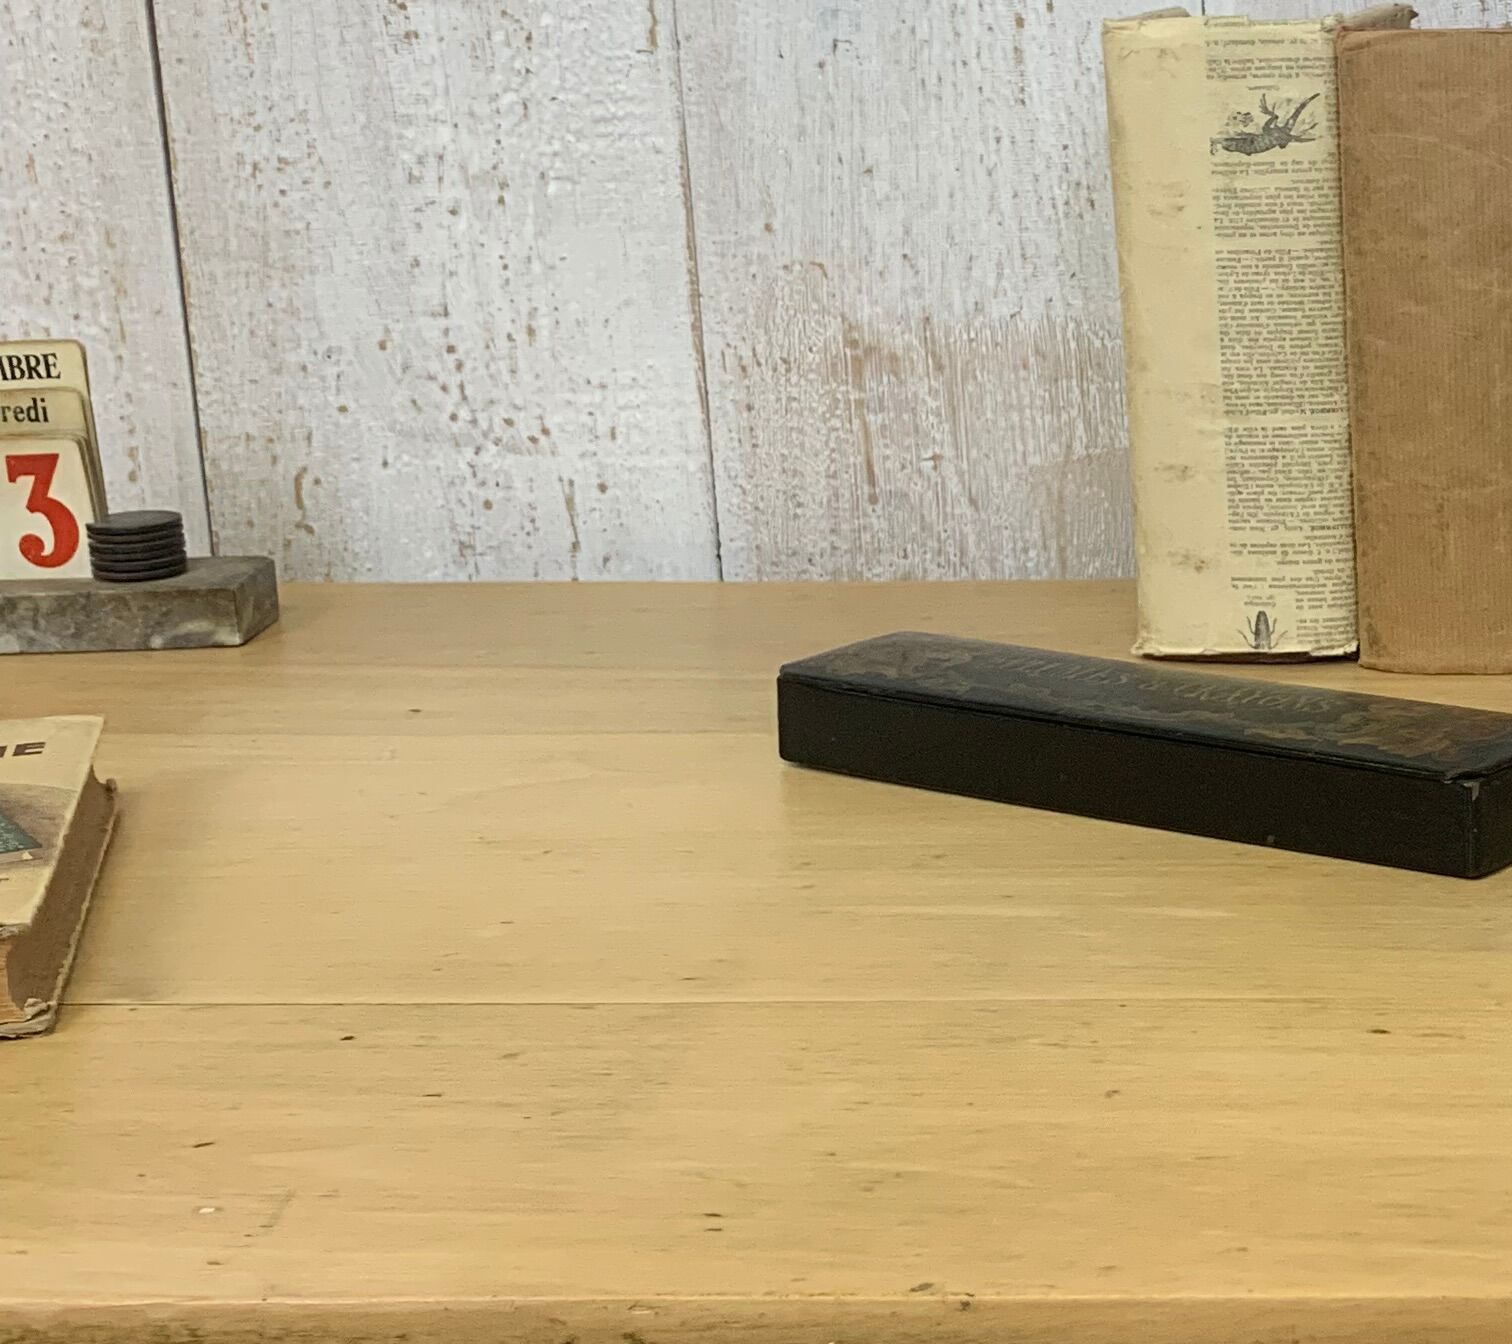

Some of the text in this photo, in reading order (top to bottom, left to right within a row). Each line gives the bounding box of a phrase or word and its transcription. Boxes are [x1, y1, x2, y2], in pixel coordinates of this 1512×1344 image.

[2, 398, 49, 423] redi
[5, 453, 80, 568] 3
[0, 742, 46, 757] E
